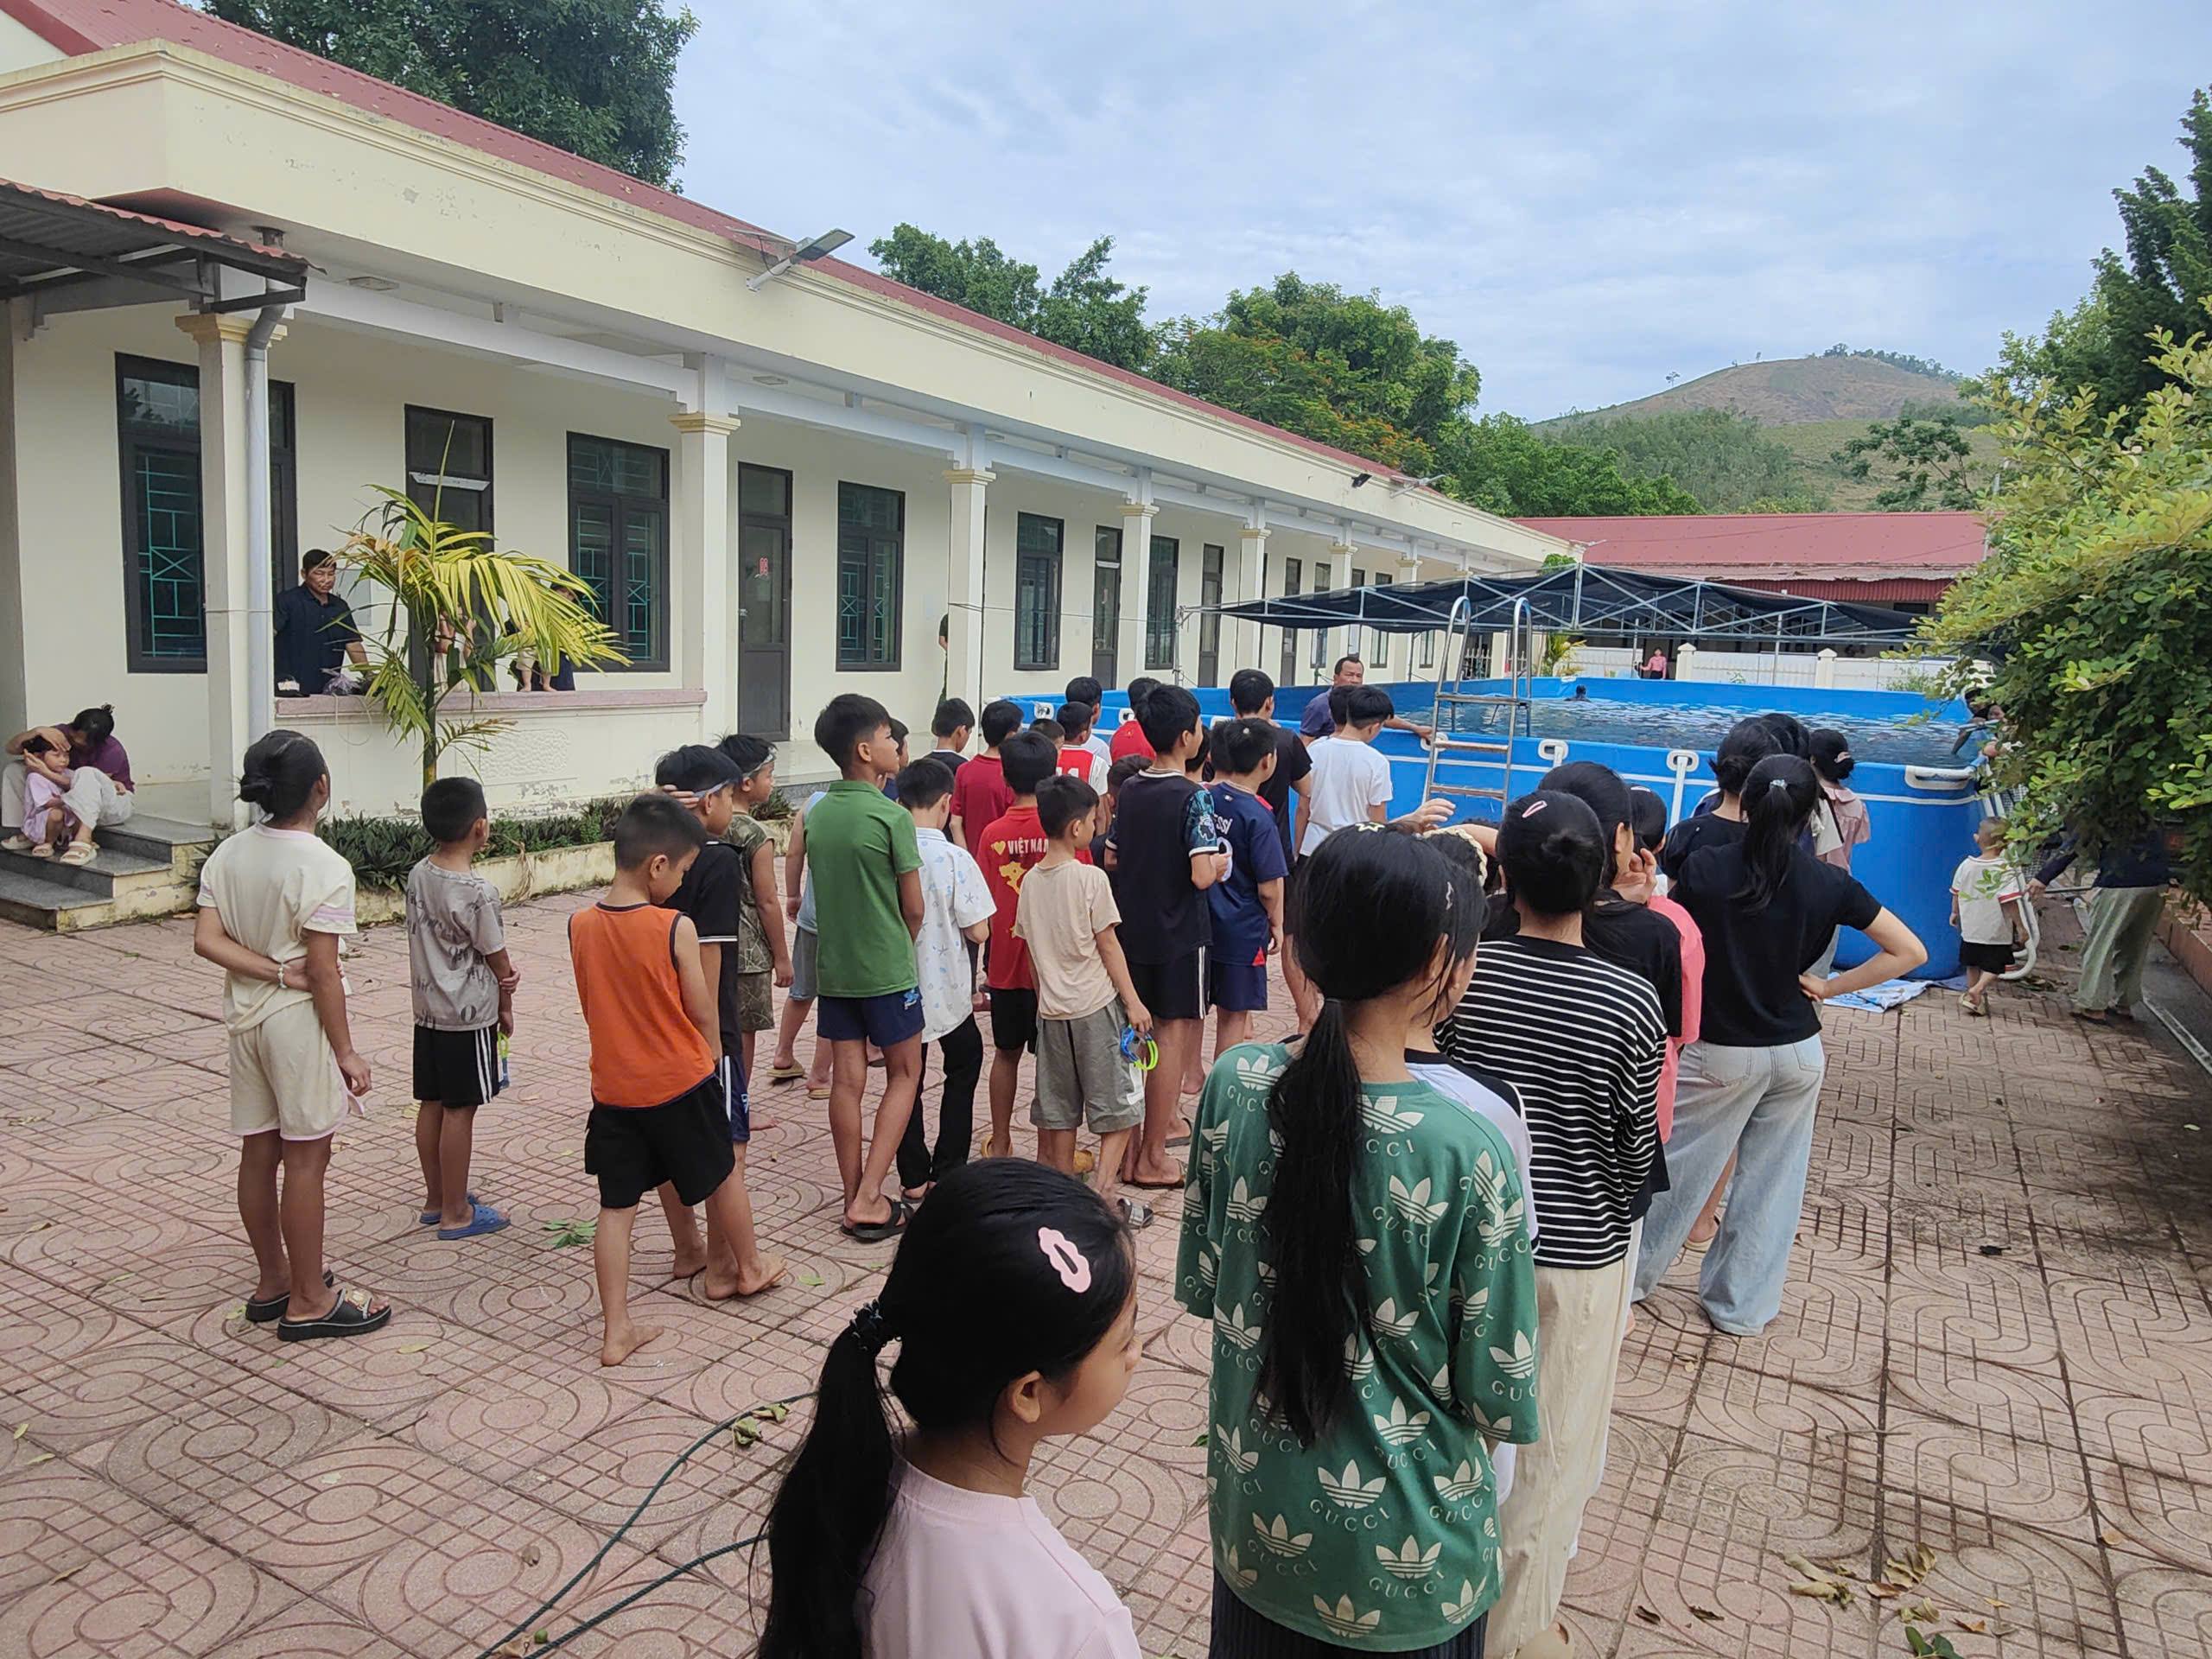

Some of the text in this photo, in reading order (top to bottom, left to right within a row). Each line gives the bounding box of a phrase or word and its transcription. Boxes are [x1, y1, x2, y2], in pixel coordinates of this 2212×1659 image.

[1213, 814, 1233, 835] SSI
[1366, 1135, 1414, 1157] CCI
[1372, 1206, 1430, 1248] GUCC
[1474, 1237, 1529, 1271] GUCC
[1310, 1499, 1390, 1532] GUCCI
[1430, 1485, 1491, 1523] GUCCI
[1248, 1539, 1319, 1576] GUCCI
[1370, 1570, 1445, 1599] GUCCI
